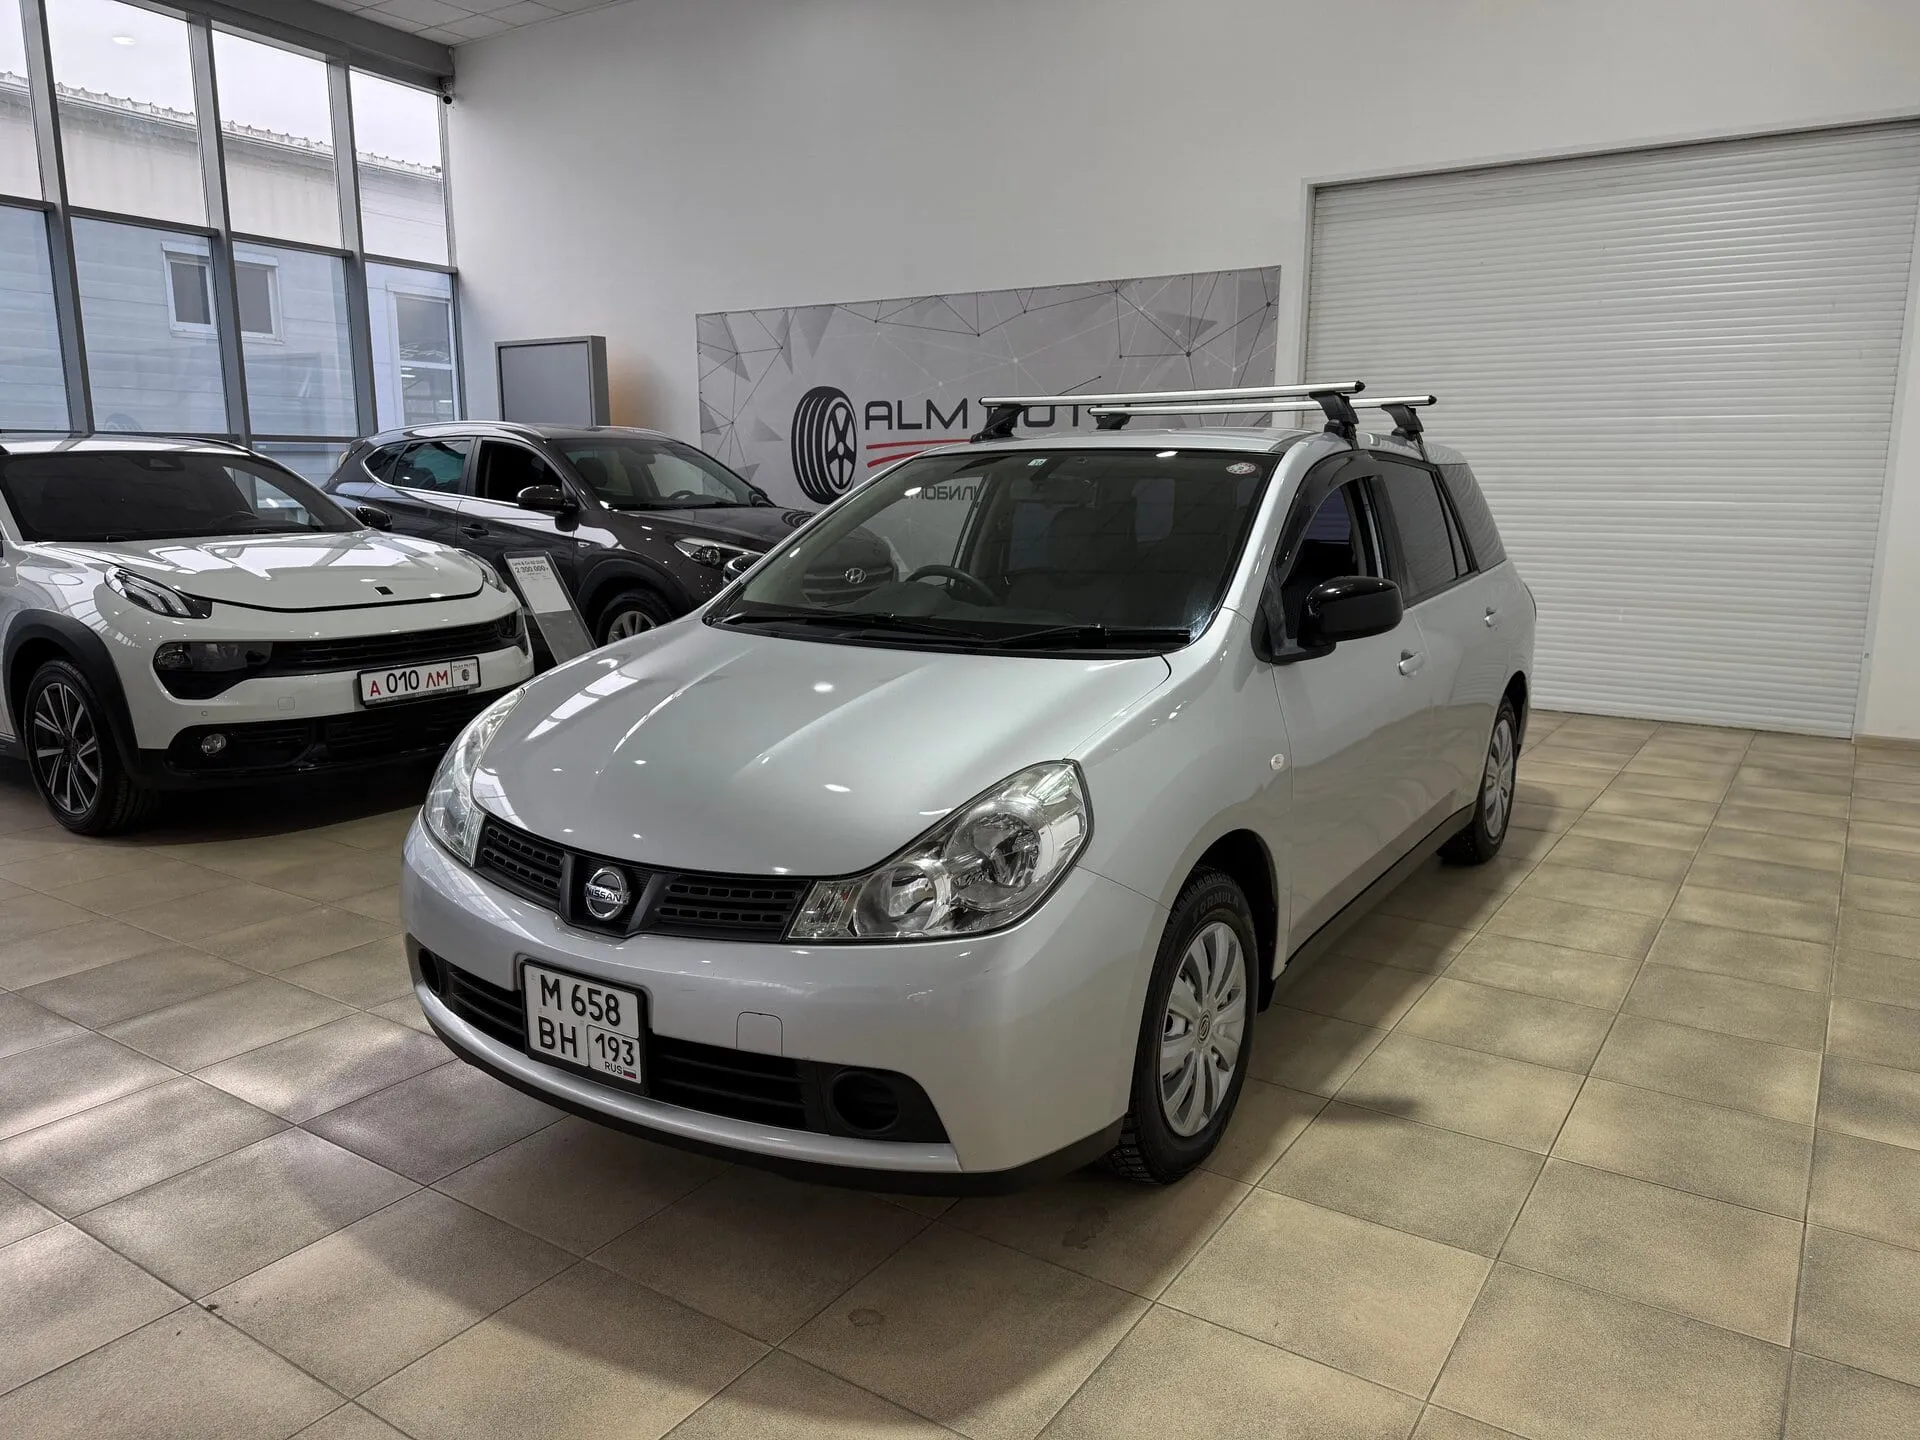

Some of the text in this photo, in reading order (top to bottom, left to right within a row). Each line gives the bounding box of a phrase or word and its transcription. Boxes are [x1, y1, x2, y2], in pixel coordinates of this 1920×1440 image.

[865, 398, 968, 430] ALM
[386, 670, 420, 693] 010
[571, 984, 621, 1027] 658
[595, 1033, 634, 1066] 193
[604, 1062, 623, 1075] RUS
